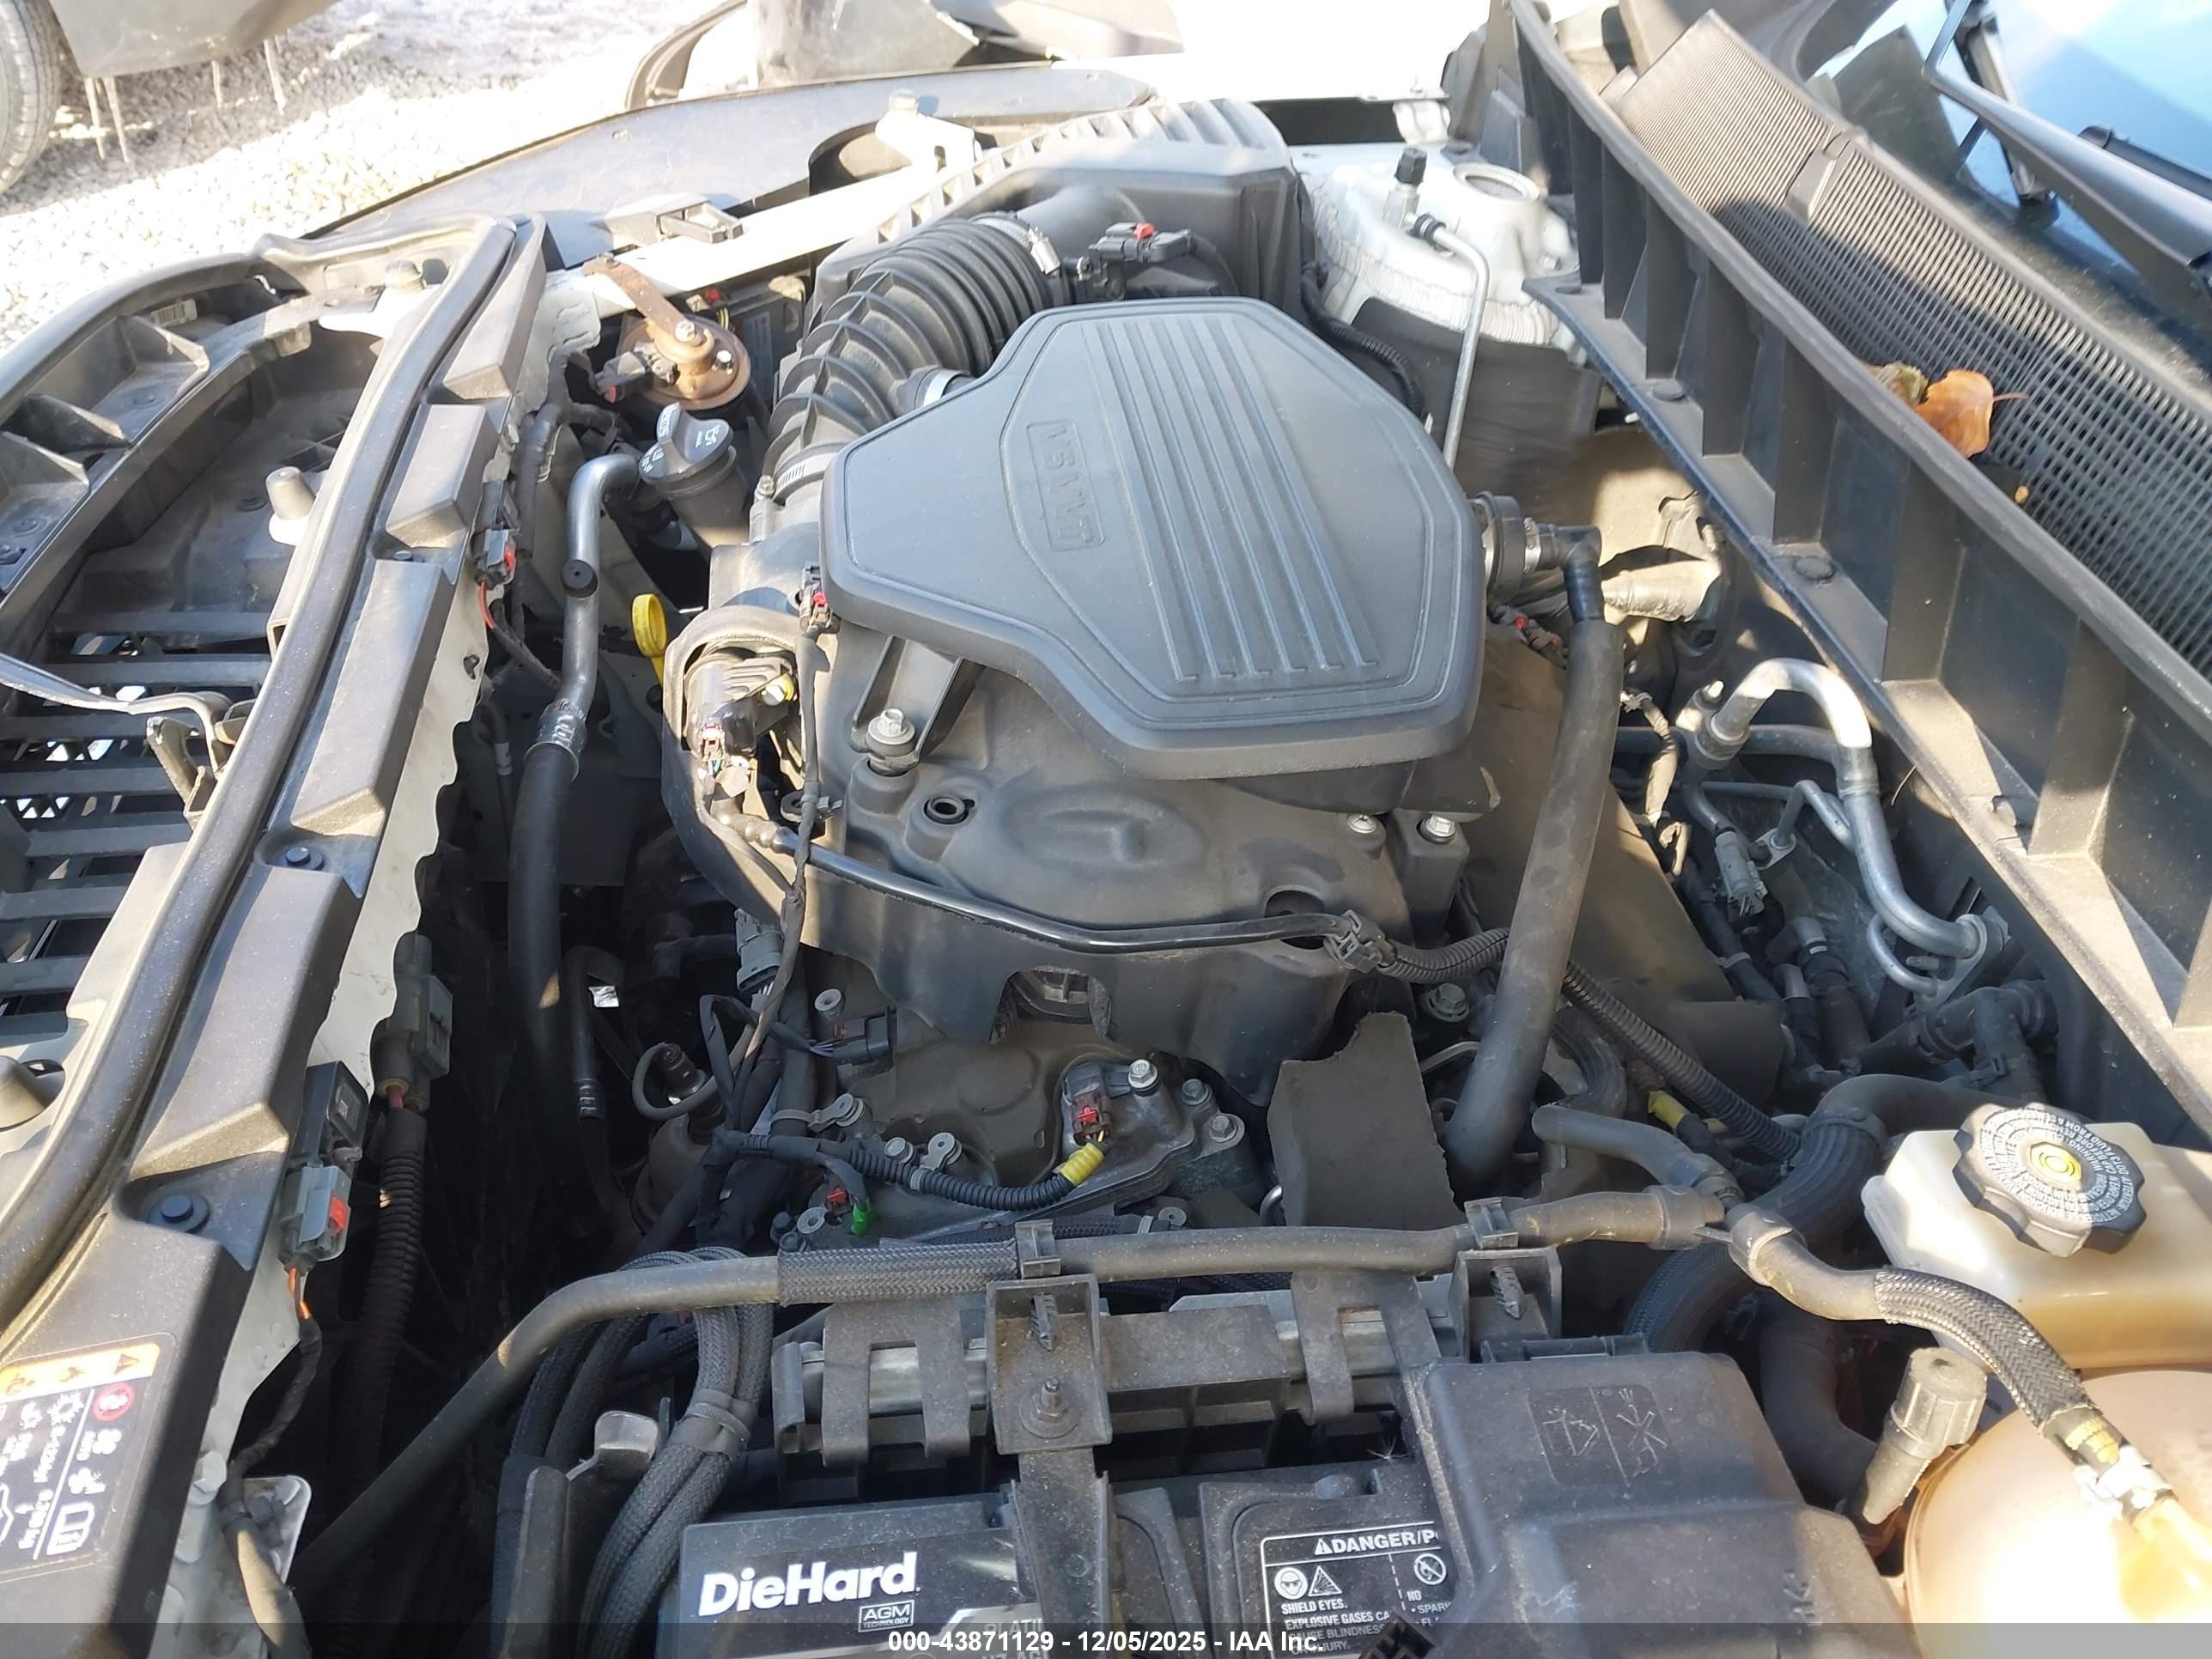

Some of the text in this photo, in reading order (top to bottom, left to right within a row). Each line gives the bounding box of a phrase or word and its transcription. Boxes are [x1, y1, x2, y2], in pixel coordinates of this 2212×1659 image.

[697, 1551, 918, 1616] DieHard
[1407, 1589, 1422, 1601] NO
[863, 1604, 910, 1621] AGM
[1281, 1598, 1348, 1615] SHIELD EYES.
[863, 1618, 909, 1629] TECHNOLOGY
[1285, 1614, 1340, 1631] EXPLOSIVE
[1341, 1612, 1374, 1623] GASES
